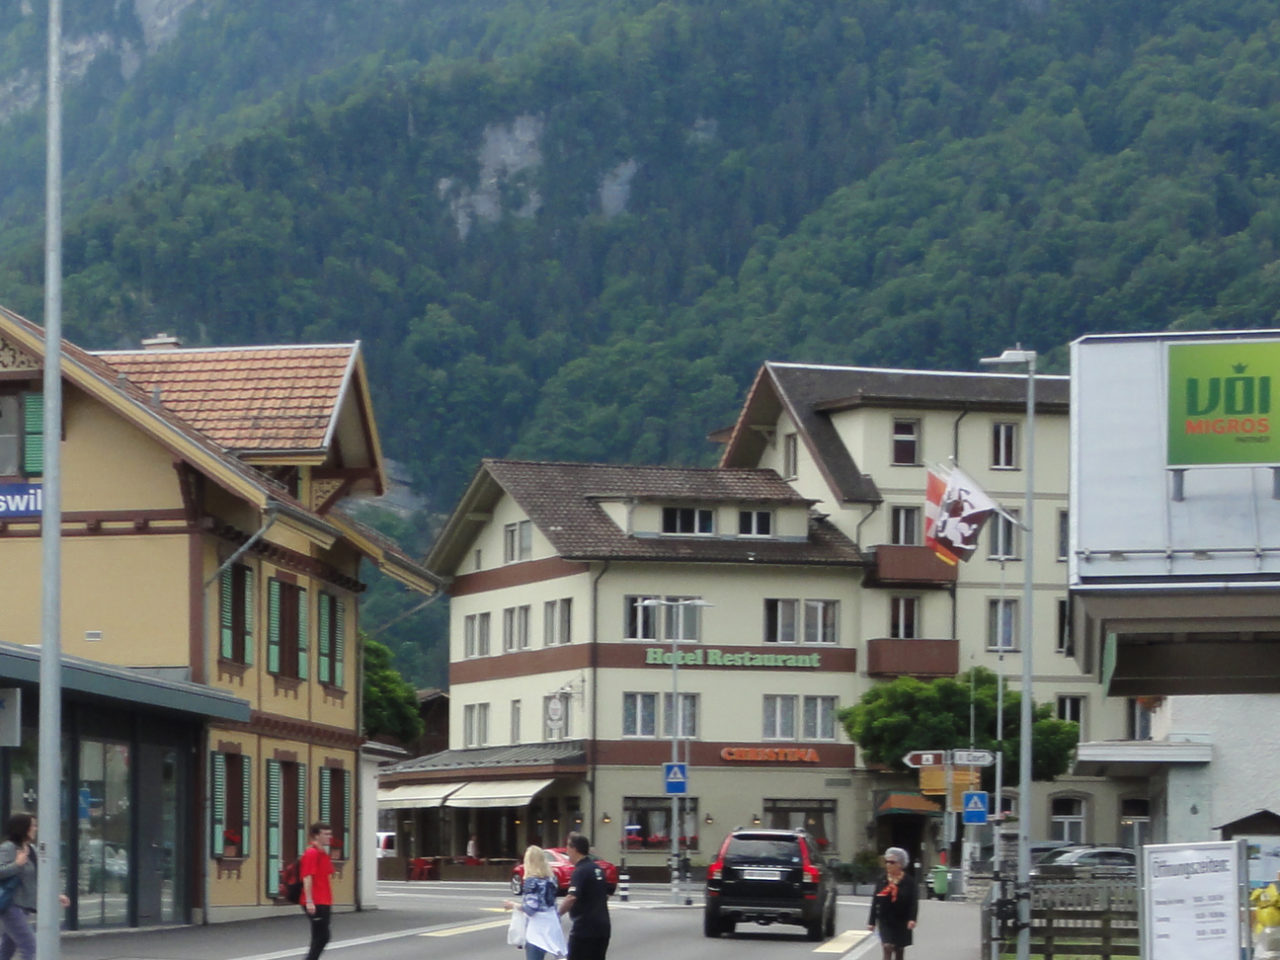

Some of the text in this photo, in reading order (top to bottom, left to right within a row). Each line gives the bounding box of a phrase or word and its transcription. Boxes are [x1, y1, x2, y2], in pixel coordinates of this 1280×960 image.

[1185, 418, 1270, 434] MIGROS
[646, 649, 821, 667] Hotel Restaurant
[720, 747, 820, 762] CHRISTINA
